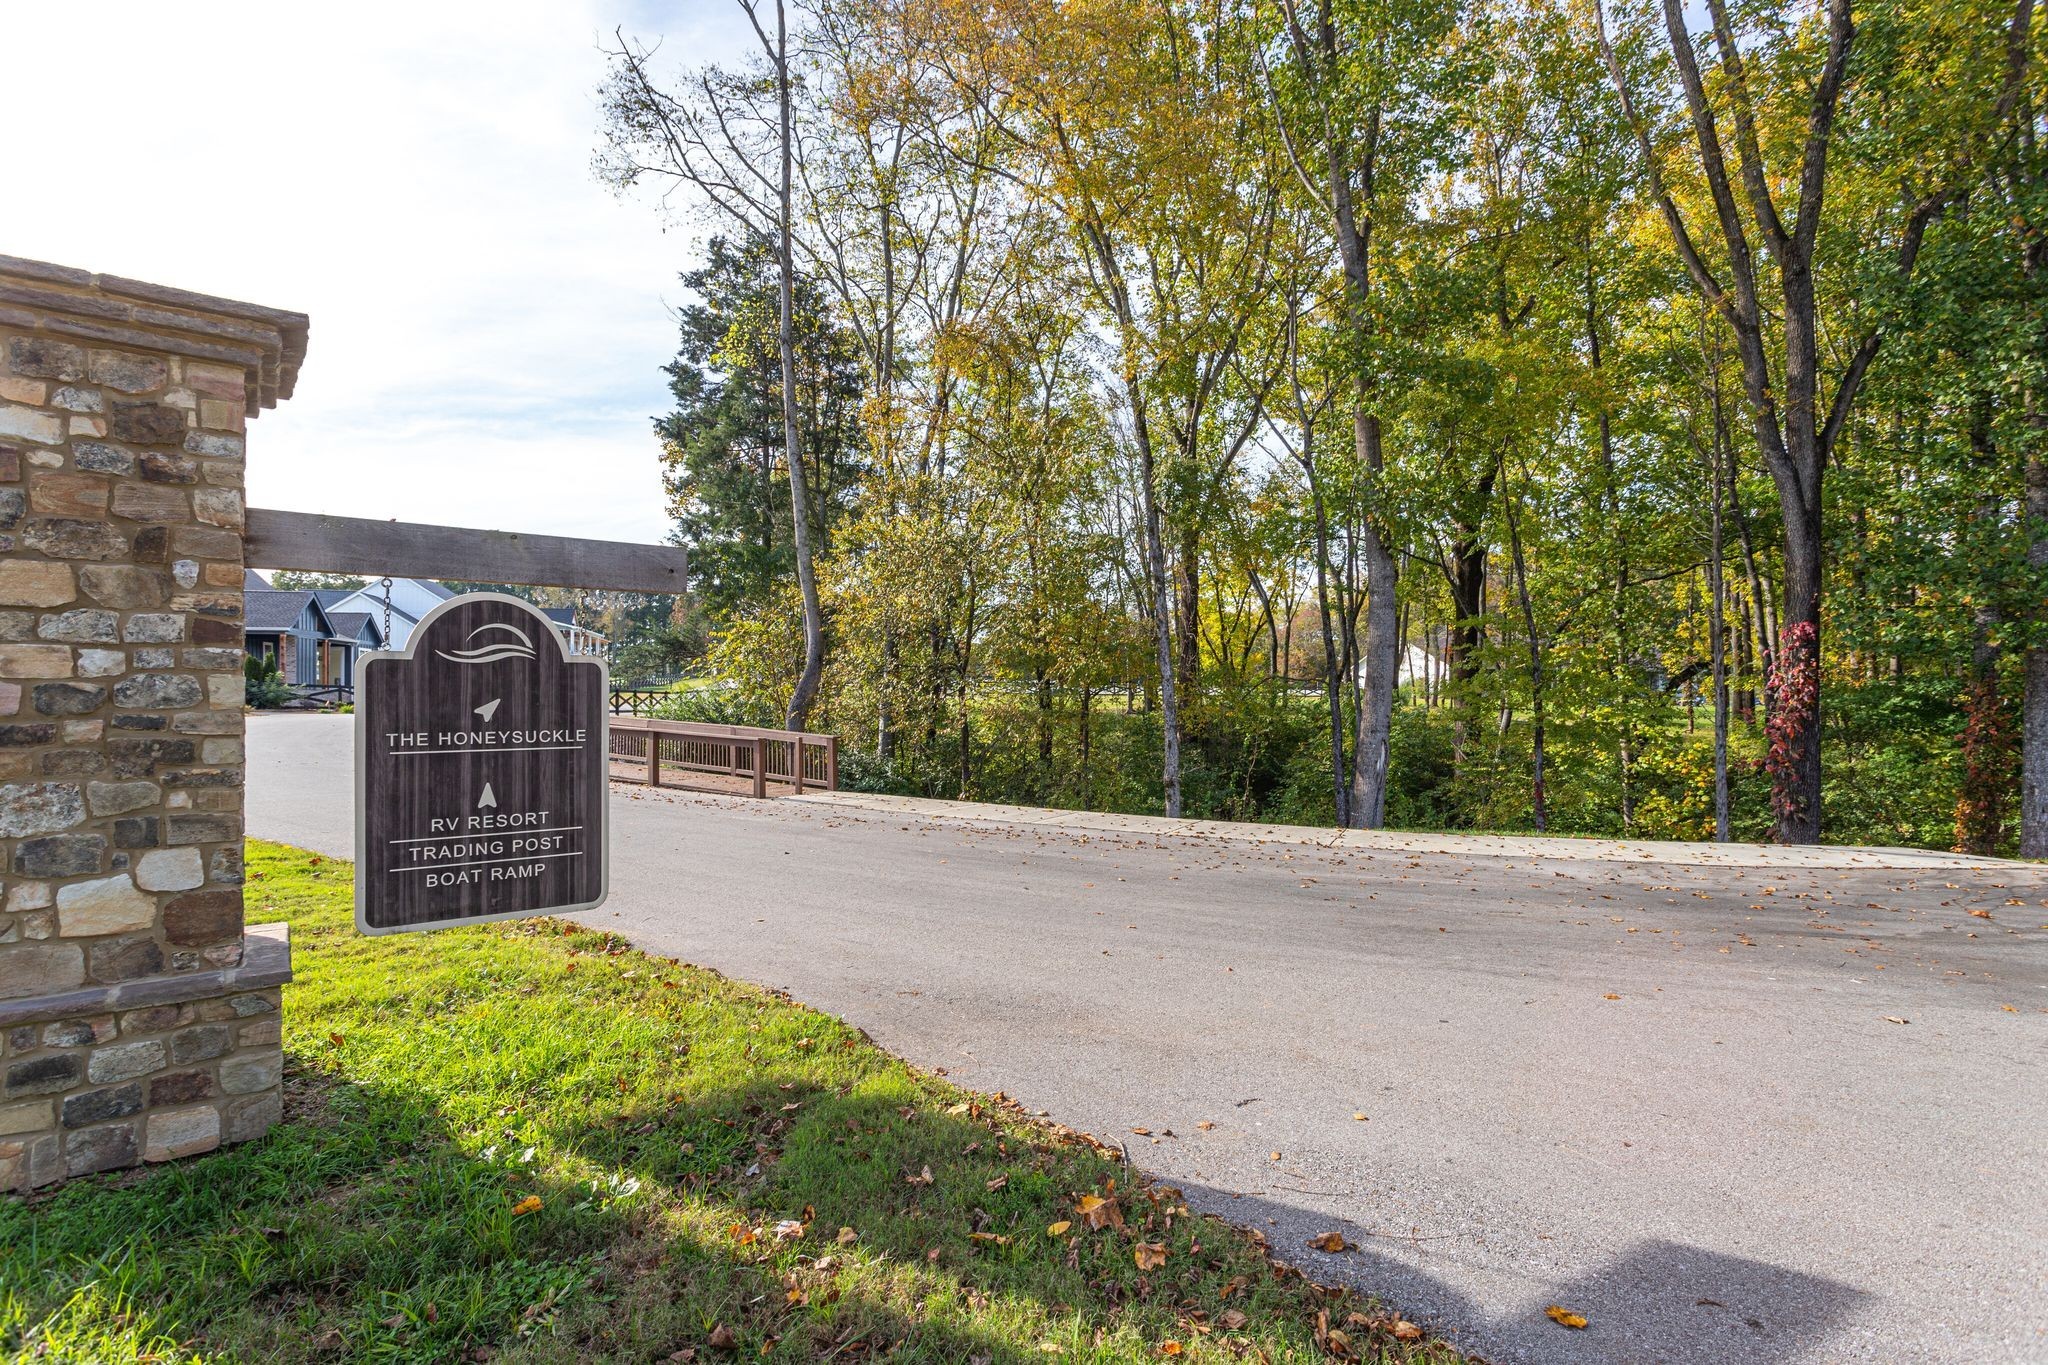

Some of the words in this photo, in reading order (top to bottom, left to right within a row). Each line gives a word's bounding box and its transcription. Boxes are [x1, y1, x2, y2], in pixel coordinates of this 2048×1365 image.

[386, 732, 429, 747] THE
[438, 729, 587, 746] HONEYSUCKLE
[431, 817, 460, 832] RV
[467, 811, 550, 830] RESORT
[408, 841, 504, 861] TRADING
[512, 835, 564, 853] POST
[426, 869, 483, 888] BOAT
[490, 863, 546, 881] RAMP
